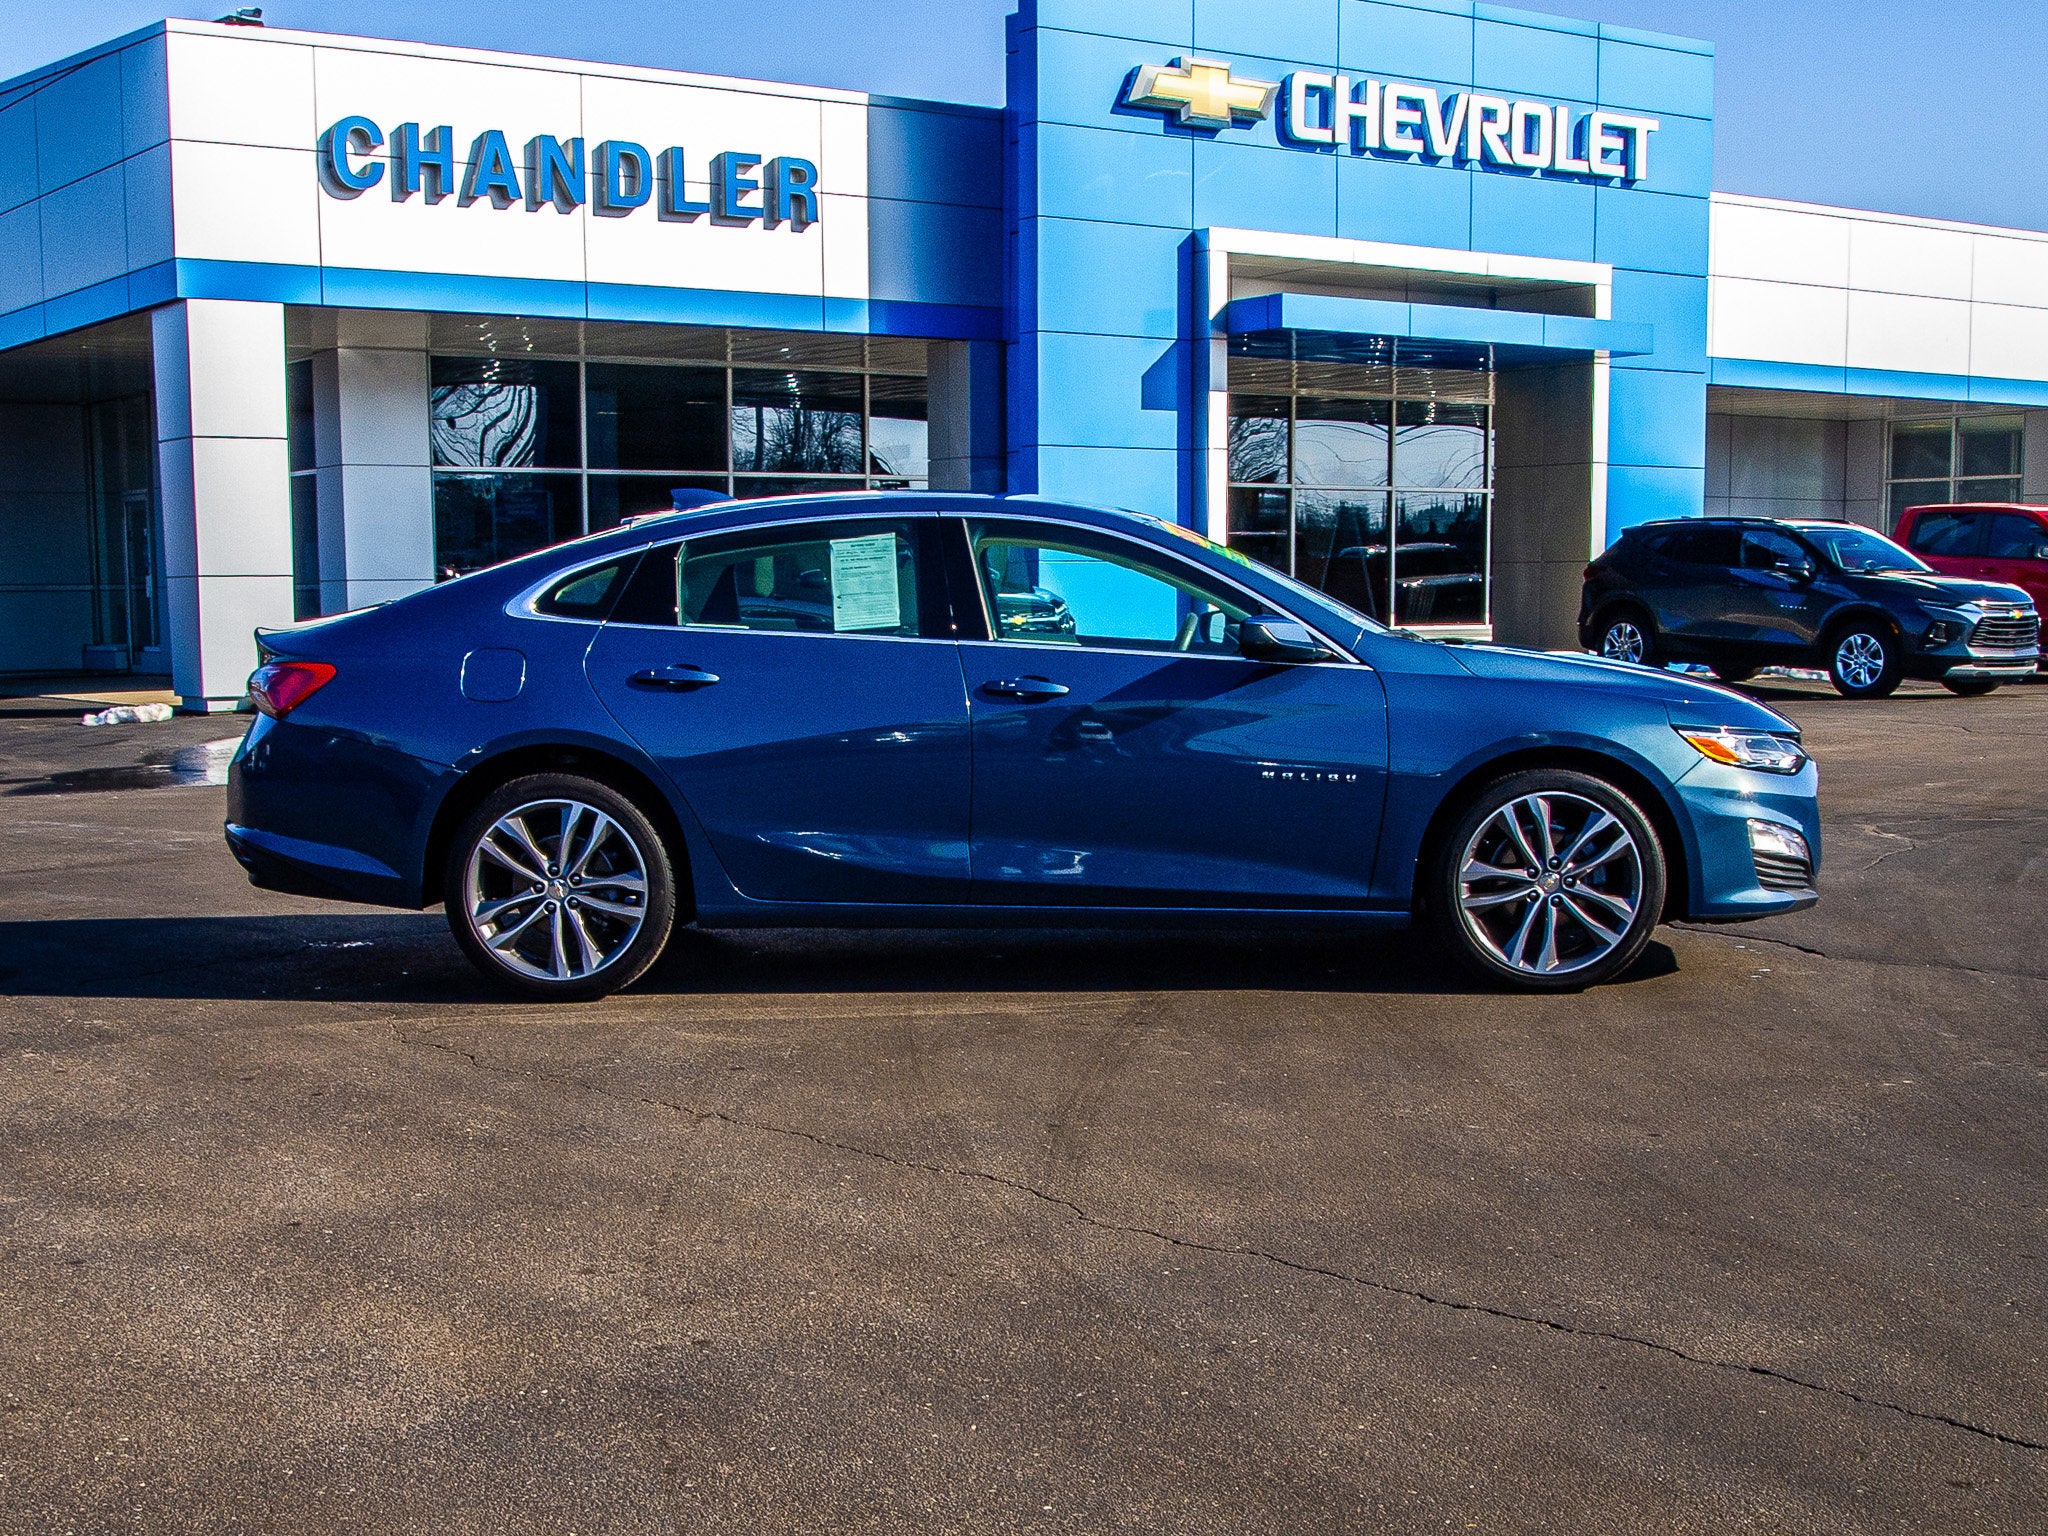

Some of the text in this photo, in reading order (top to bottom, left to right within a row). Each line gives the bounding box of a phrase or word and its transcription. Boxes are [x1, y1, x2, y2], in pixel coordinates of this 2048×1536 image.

[319, 115, 820, 232] CHANDLER
[1287, 70, 1660, 182] CHEVROLET
[1261, 771, 1357, 782] MALIBU
